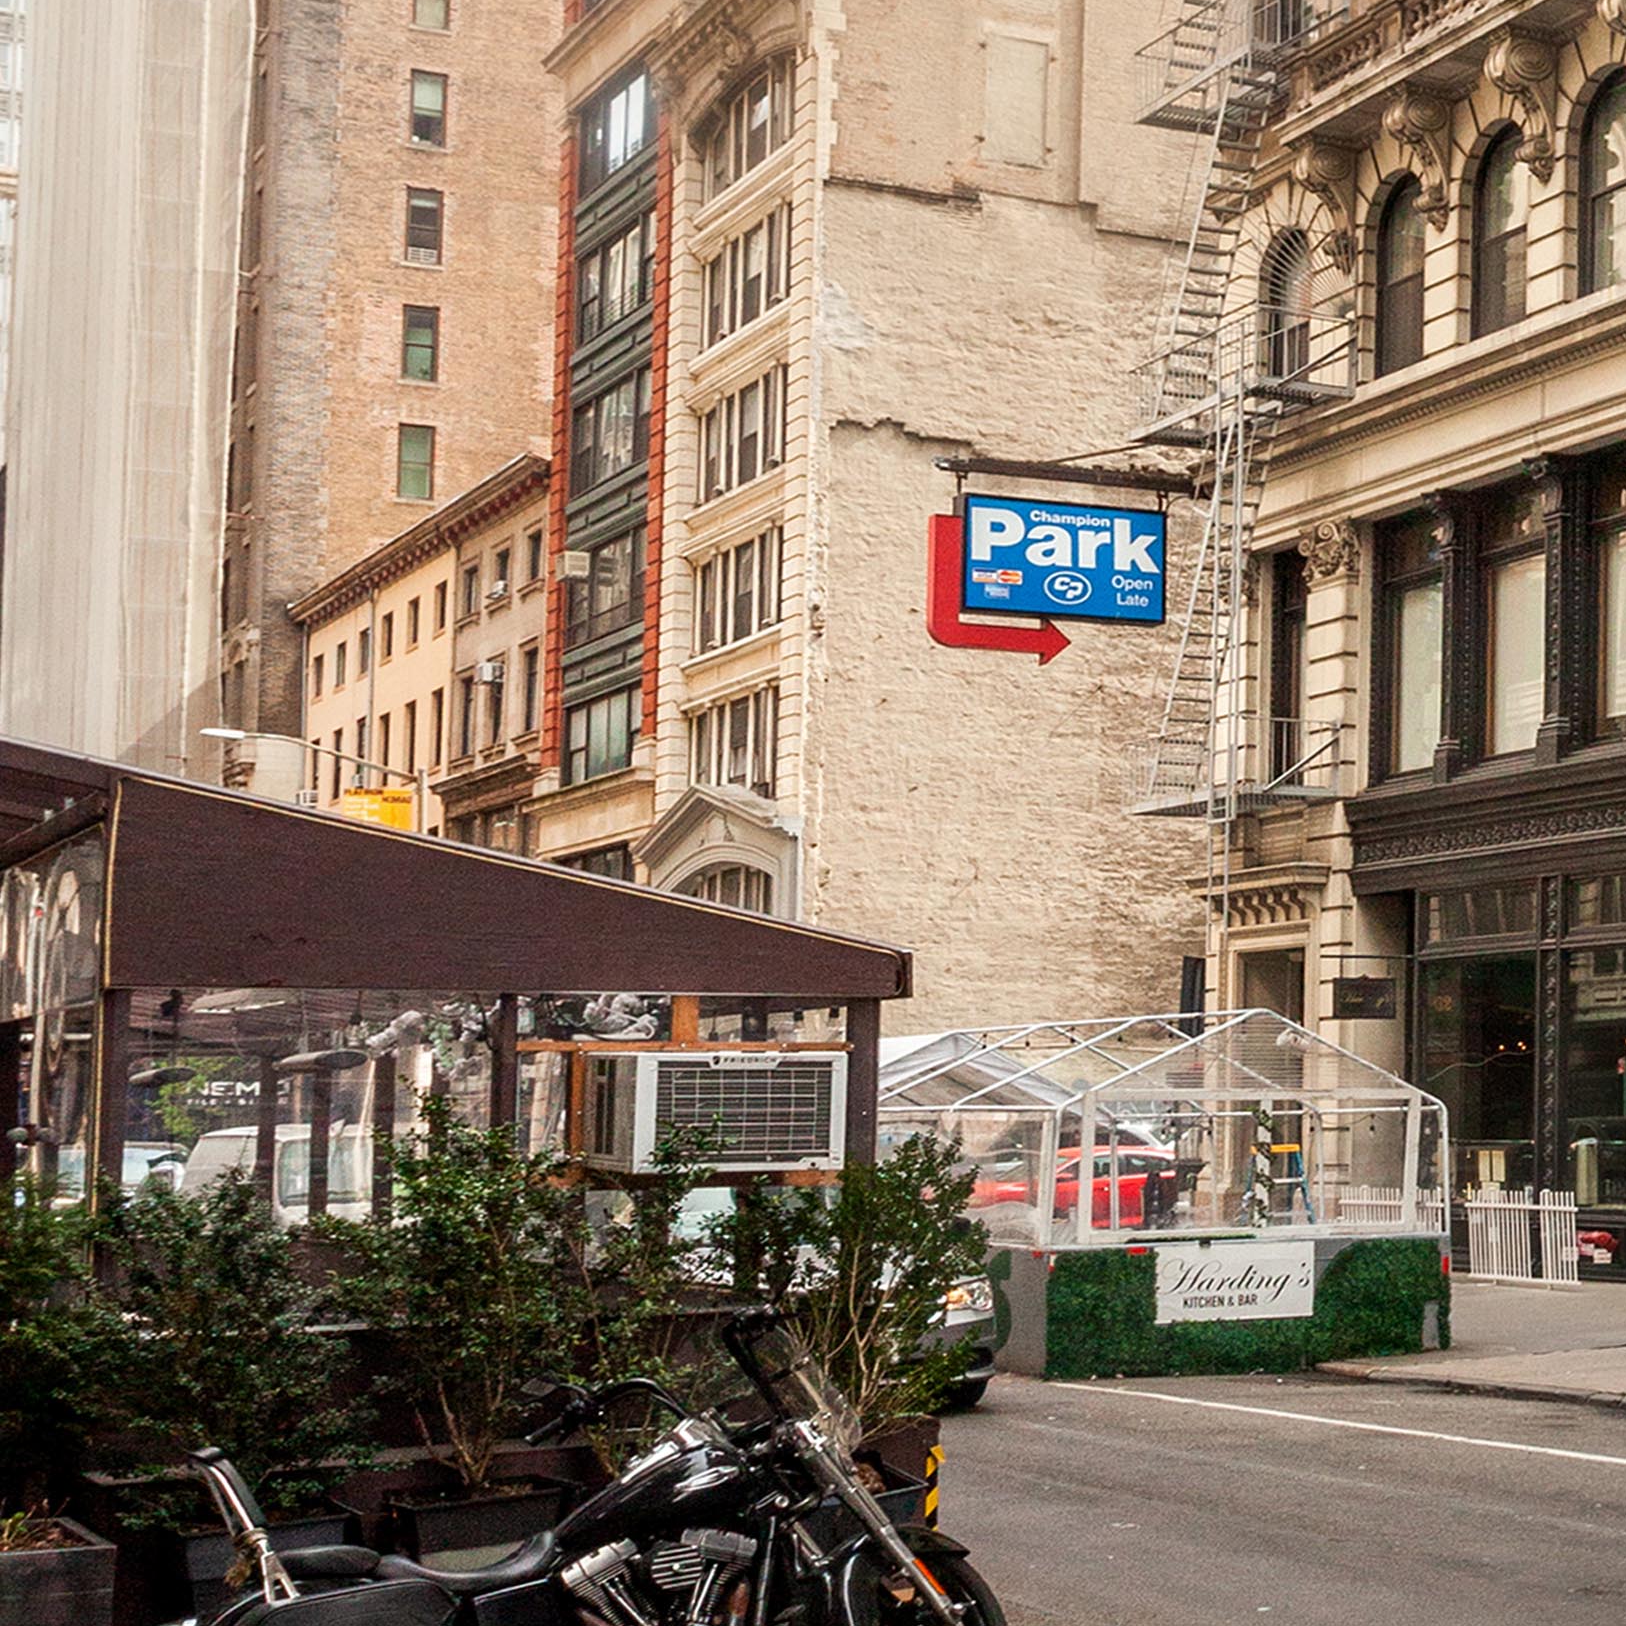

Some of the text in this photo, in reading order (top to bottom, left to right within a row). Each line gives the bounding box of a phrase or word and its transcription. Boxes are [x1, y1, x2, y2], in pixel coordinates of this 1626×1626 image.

[1030, 510, 1111, 528] Champion
[970, 506, 1160, 574] Park
[1111, 575, 1153, 592] Open
[1116, 592, 1149, 607] Late
[1157, 1258, 1312, 1304] Harding's
[1182, 1294, 1259, 1309] KITCHEN & BAR
